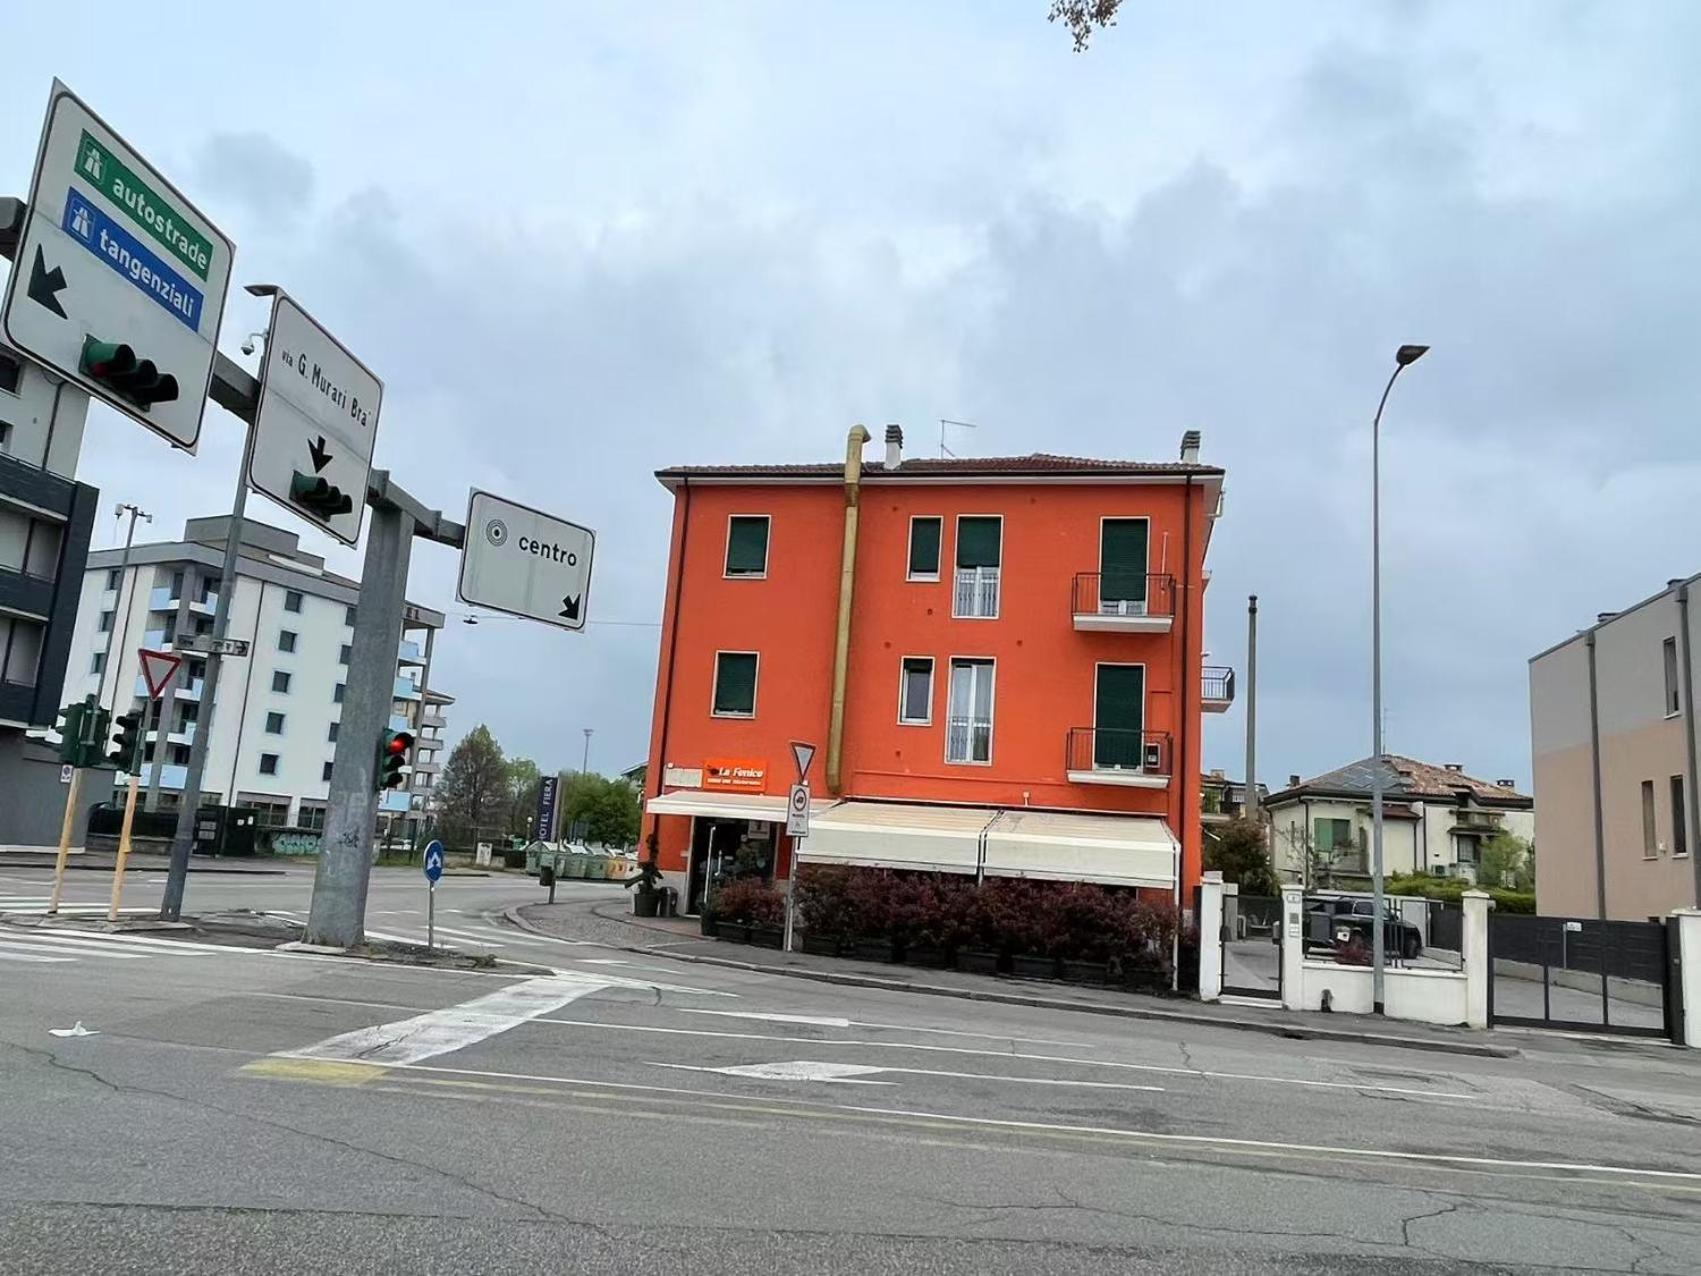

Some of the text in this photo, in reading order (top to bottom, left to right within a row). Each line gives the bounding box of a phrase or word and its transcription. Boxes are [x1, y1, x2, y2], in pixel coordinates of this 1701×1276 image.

[112, 177, 208, 270] autostrade
[99, 230, 195, 318] tangenziali
[281, 349, 294, 368] via
[298, 353, 309, 380] G.
[311, 363, 347, 409] Murari
[518, 536, 577, 567] centro
